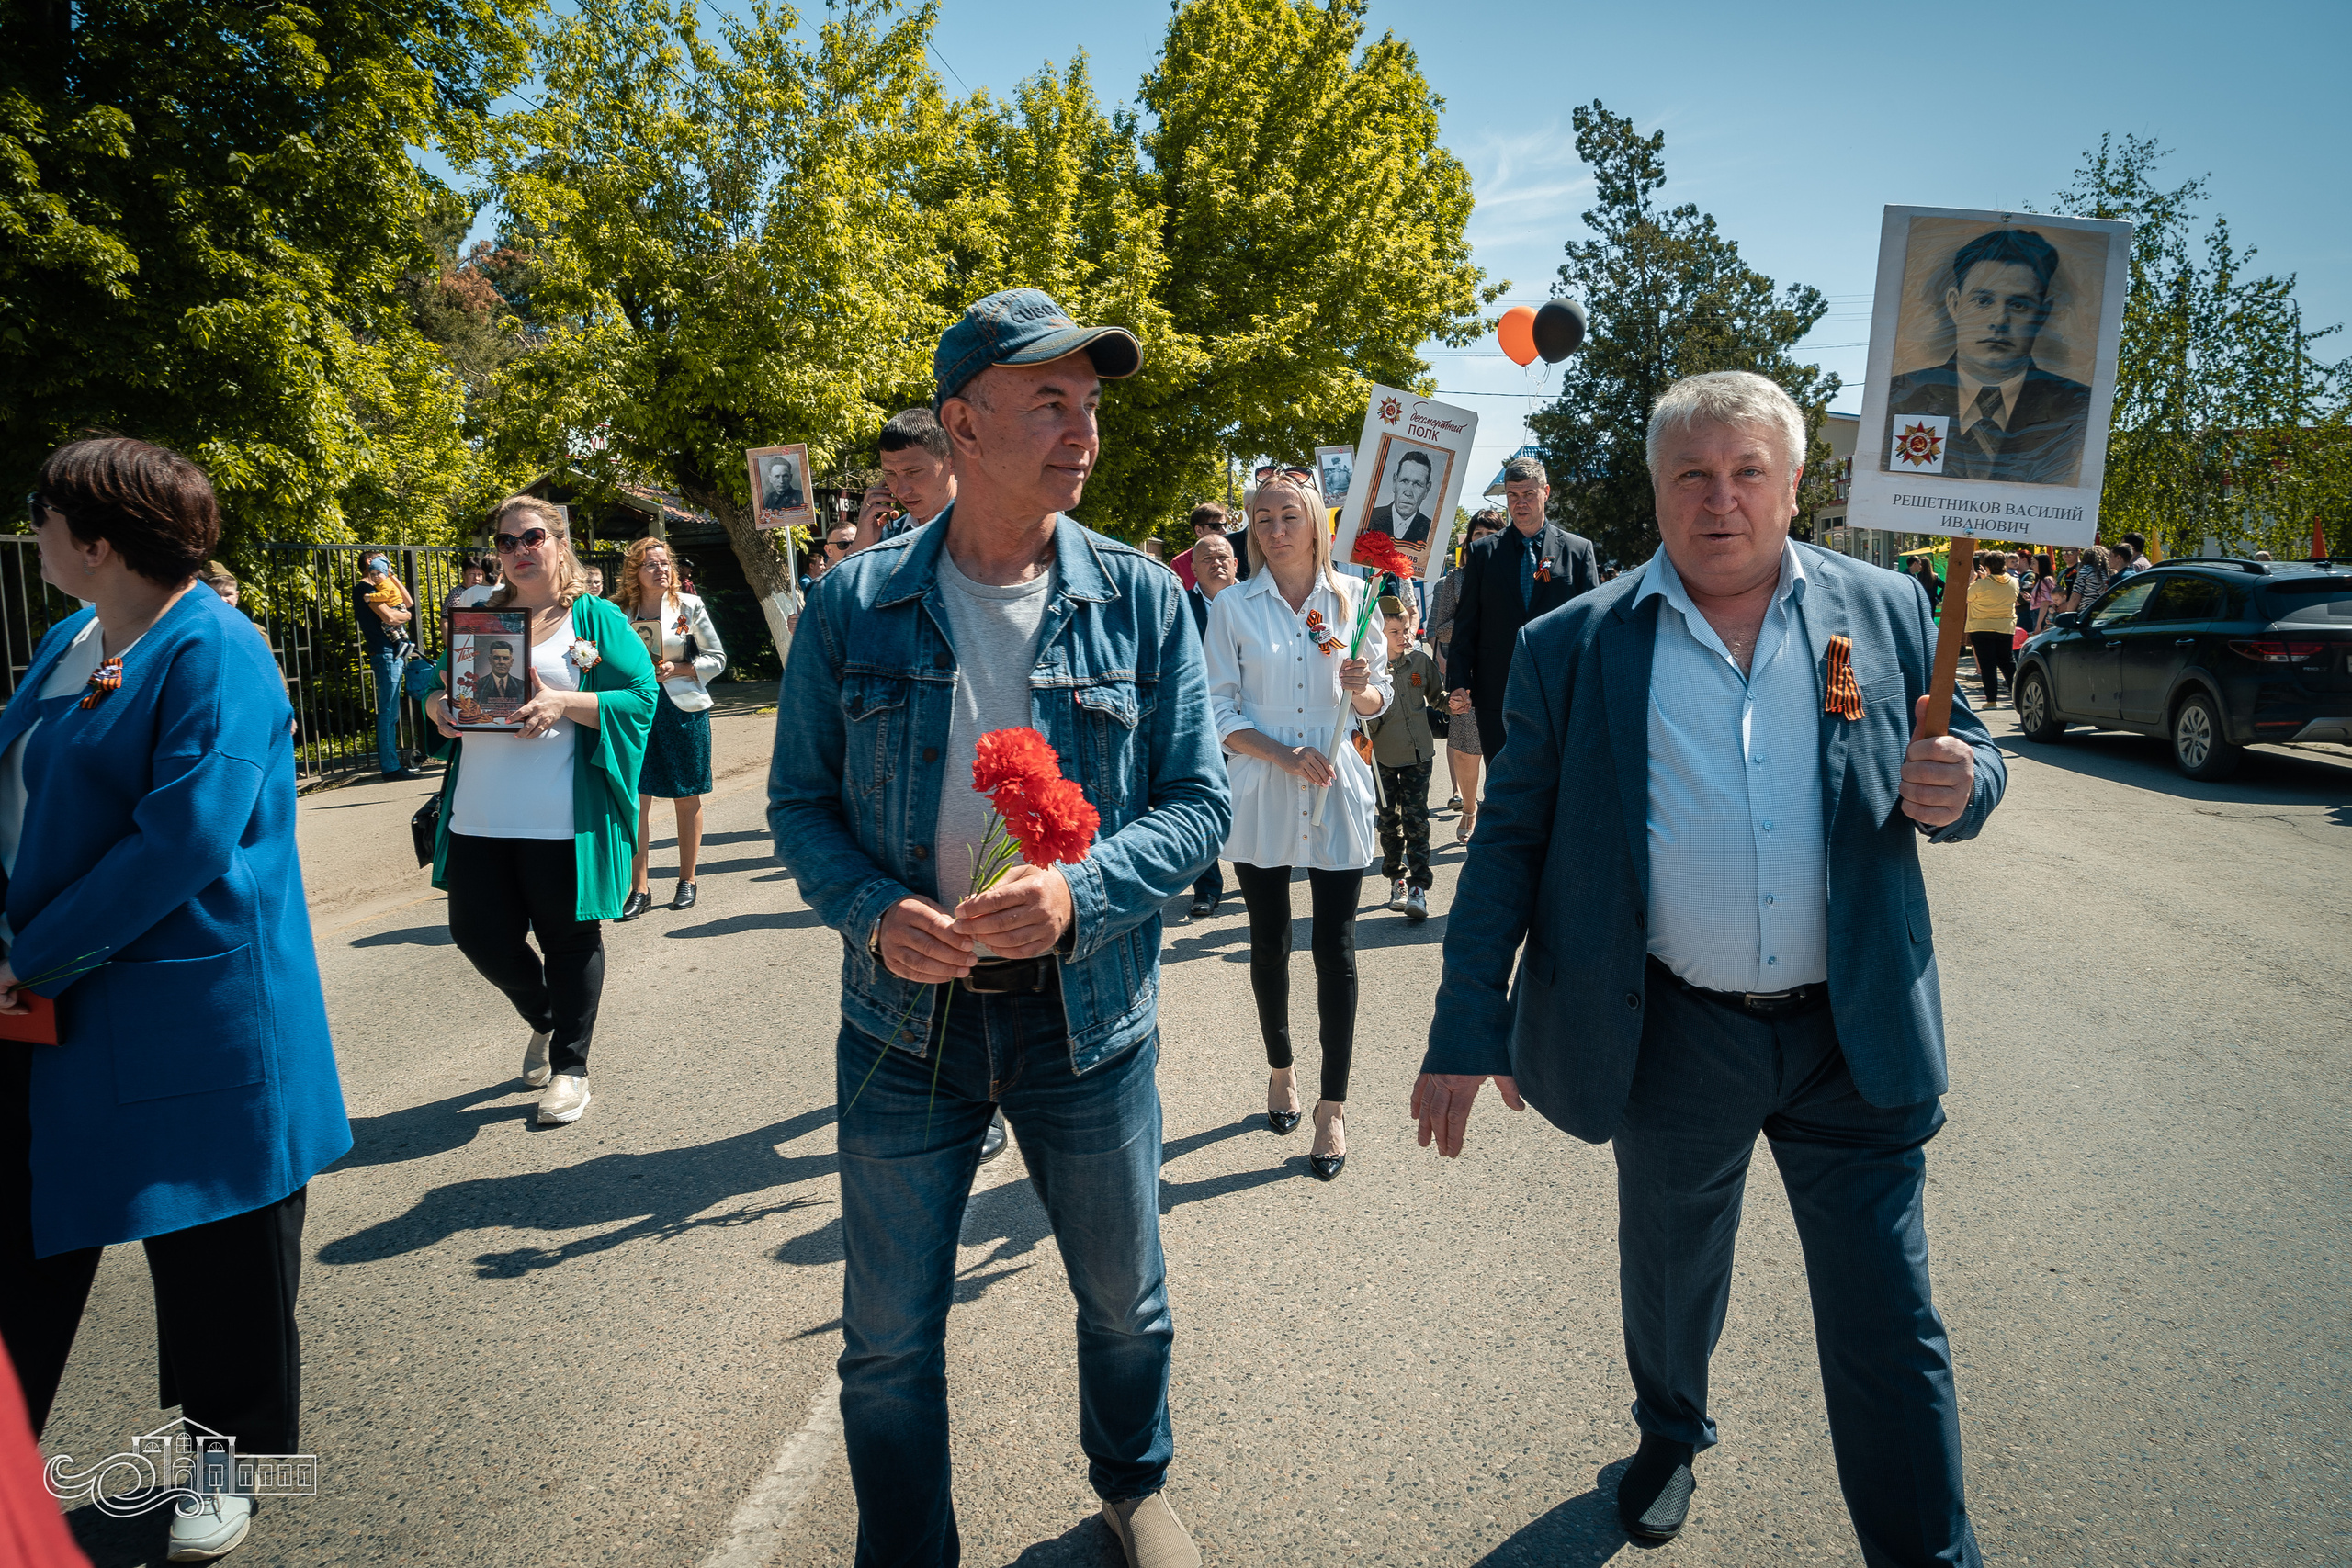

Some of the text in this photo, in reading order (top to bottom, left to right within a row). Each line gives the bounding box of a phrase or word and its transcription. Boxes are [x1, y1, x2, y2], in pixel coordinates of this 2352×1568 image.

[1011, 304, 1057, 323] CUBA
[1408, 423, 1440, 442] ПОЛК
[1892, 493, 2084, 521] РЕШЕТНИКОВ ВАСИЛИЙ
[1939, 515, 2030, 535] ИВАНОВИЧ
